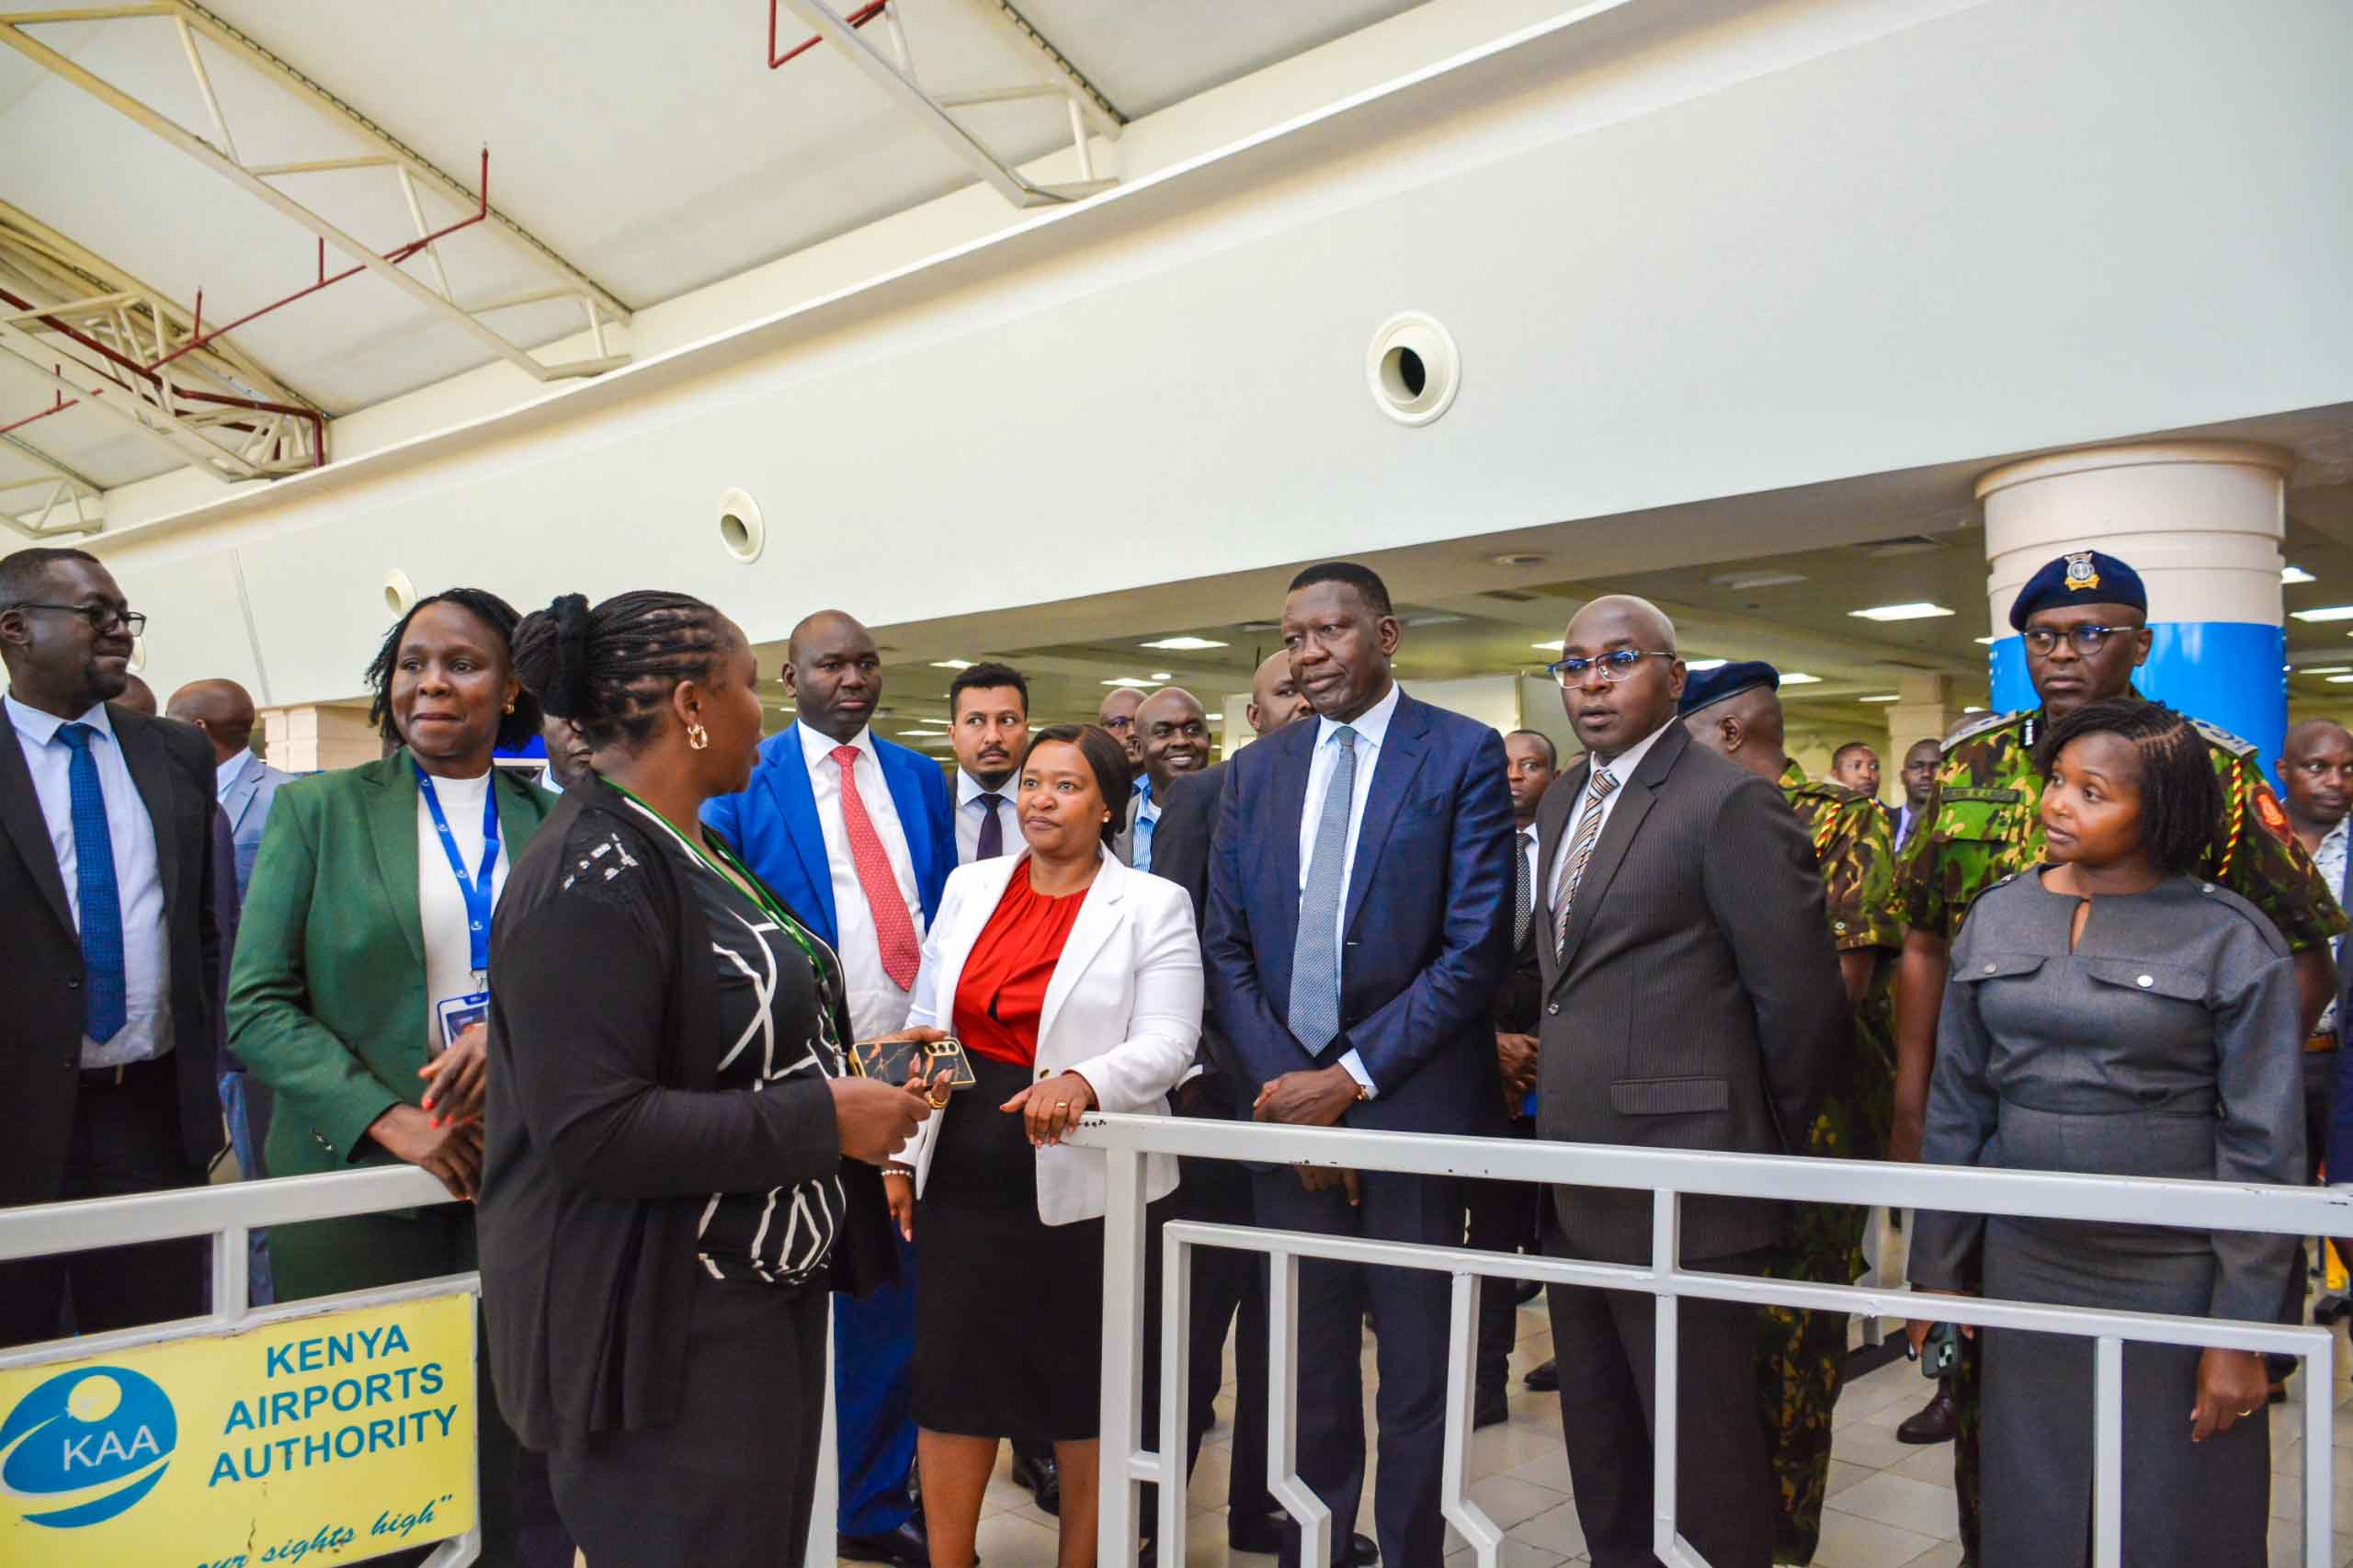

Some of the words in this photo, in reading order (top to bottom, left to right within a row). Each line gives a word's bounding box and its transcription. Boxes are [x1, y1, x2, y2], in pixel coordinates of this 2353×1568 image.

[267, 1324, 409, 1379] KENYA
[224, 1363, 443, 1435] AIRPORTS
[63, 1426, 160, 1471] KAA
[209, 1405, 458, 1487] AUTHORITY
[260, 1525, 355, 1563] sights
